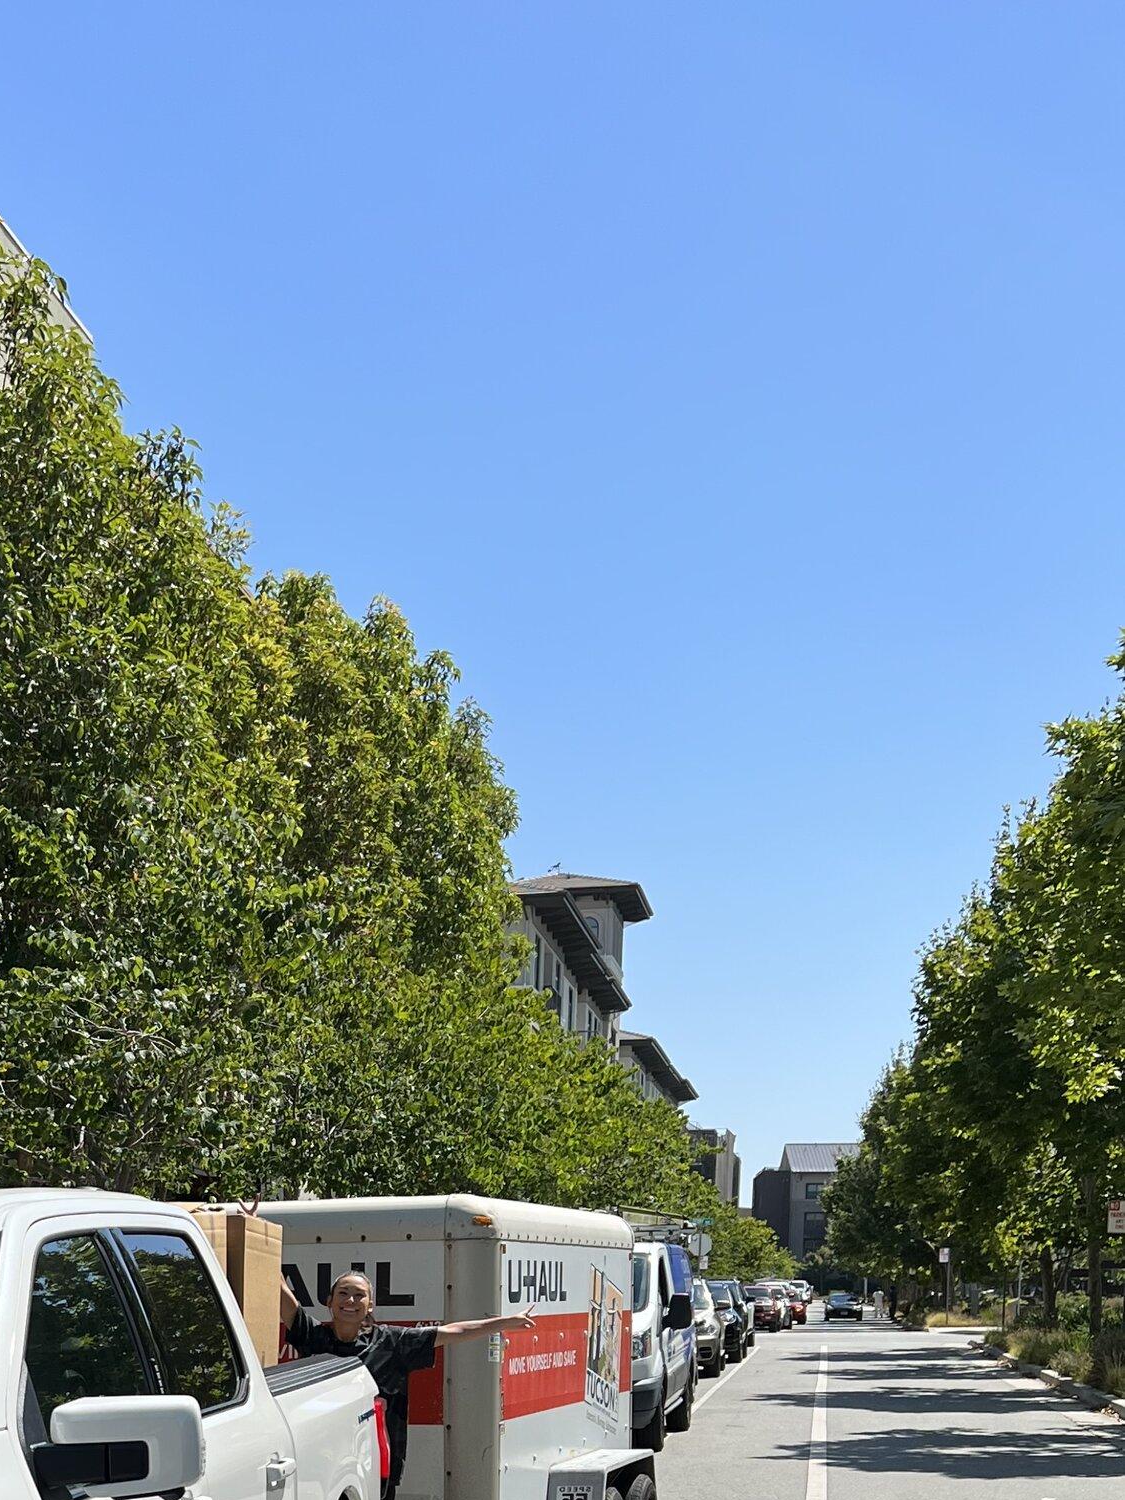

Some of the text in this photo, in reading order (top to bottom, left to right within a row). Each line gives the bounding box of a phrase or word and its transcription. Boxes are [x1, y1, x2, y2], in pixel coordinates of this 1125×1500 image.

[509, 1349, 577, 1375] MOVE YOURSELF AND SAVE
